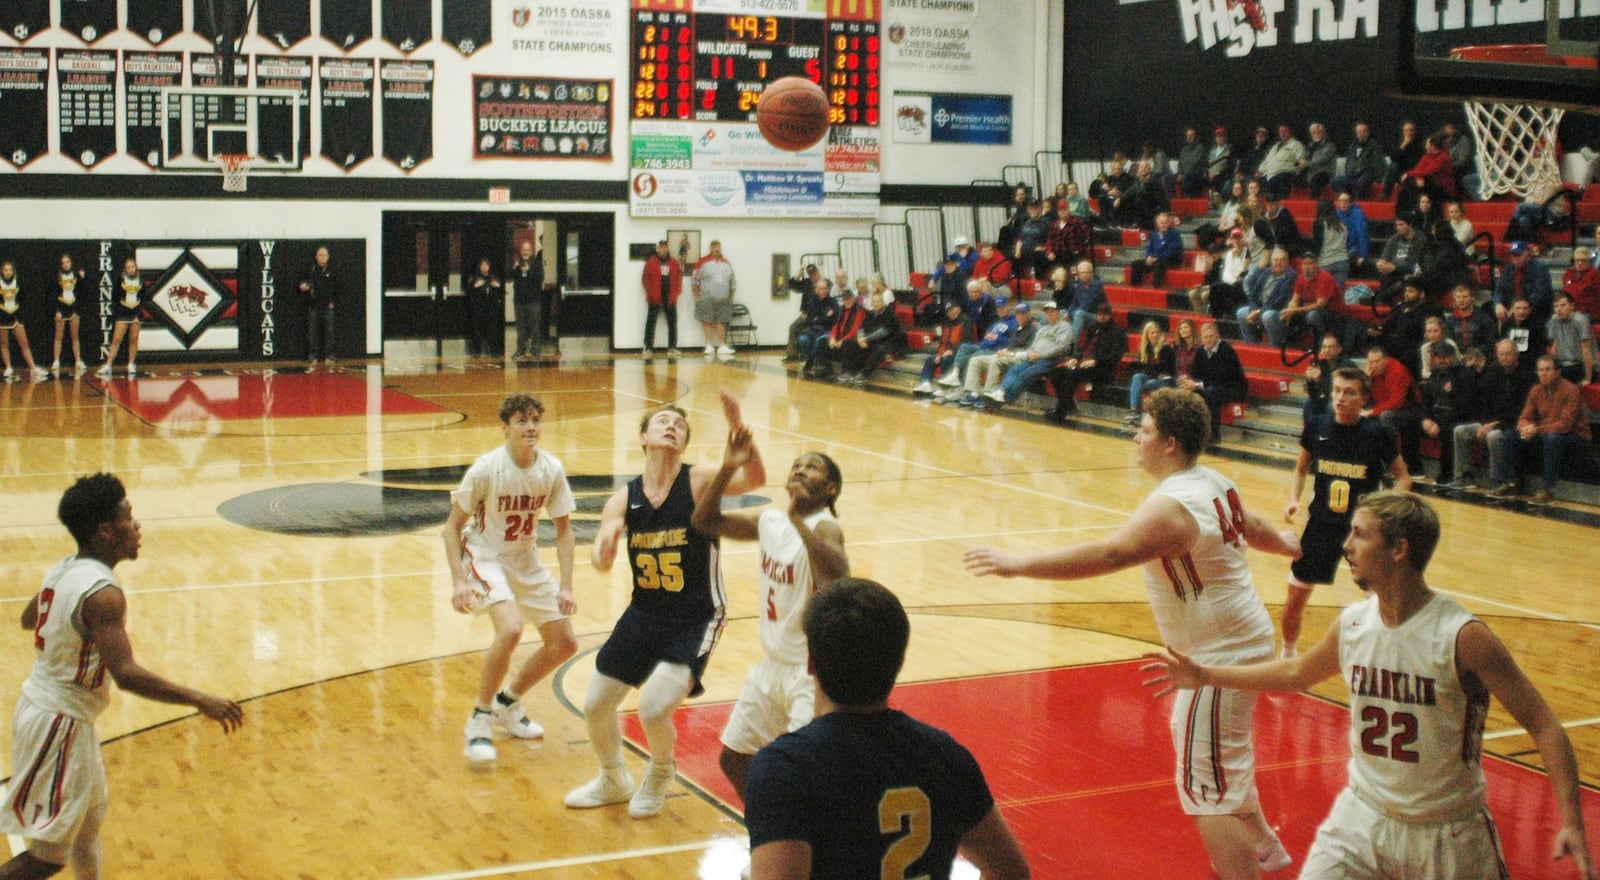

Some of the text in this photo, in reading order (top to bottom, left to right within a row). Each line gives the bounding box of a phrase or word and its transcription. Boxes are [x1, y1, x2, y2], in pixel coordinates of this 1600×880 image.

[538, 6, 611, 20] 2015 OASSA
[644, 25, 656, 43] 2
[730, 16, 778, 41] 49.3
[512, 40, 612, 53] STATE CHAMPIONS
[698, 42, 747, 55] WILDCATS
[789, 47, 819, 58] GUEST
[835, 34, 847, 52] 0
[759, 60, 767, 78] 1
[835, 53, 846, 70] 2
[636, 81, 655, 99] 22
[738, 83, 762, 91] PLAYER
[479, 102, 607, 119] SOUTHWESTERN
[636, 101, 655, 118] 24
[828, 106, 846, 124] 35
[480, 118, 607, 134] BUCKEYE LEAGUE
[951, 113, 1010, 125] Premier Health
[644, 159, 690, 169] 746-3943
[834, 173, 845, 191] 9
[260, 241, 275, 356] WILDCATS
[1330, 480, 1350, 513] 0
[504, 513, 535, 543] 24
[635, 552, 685, 593] 35
[766, 587, 778, 621] 5
[34, 587, 56, 651] 2
[1351, 665, 1437, 707] FRANKLIN
[1360, 705, 1420, 764] 22
[878, 786, 932, 880] 2
